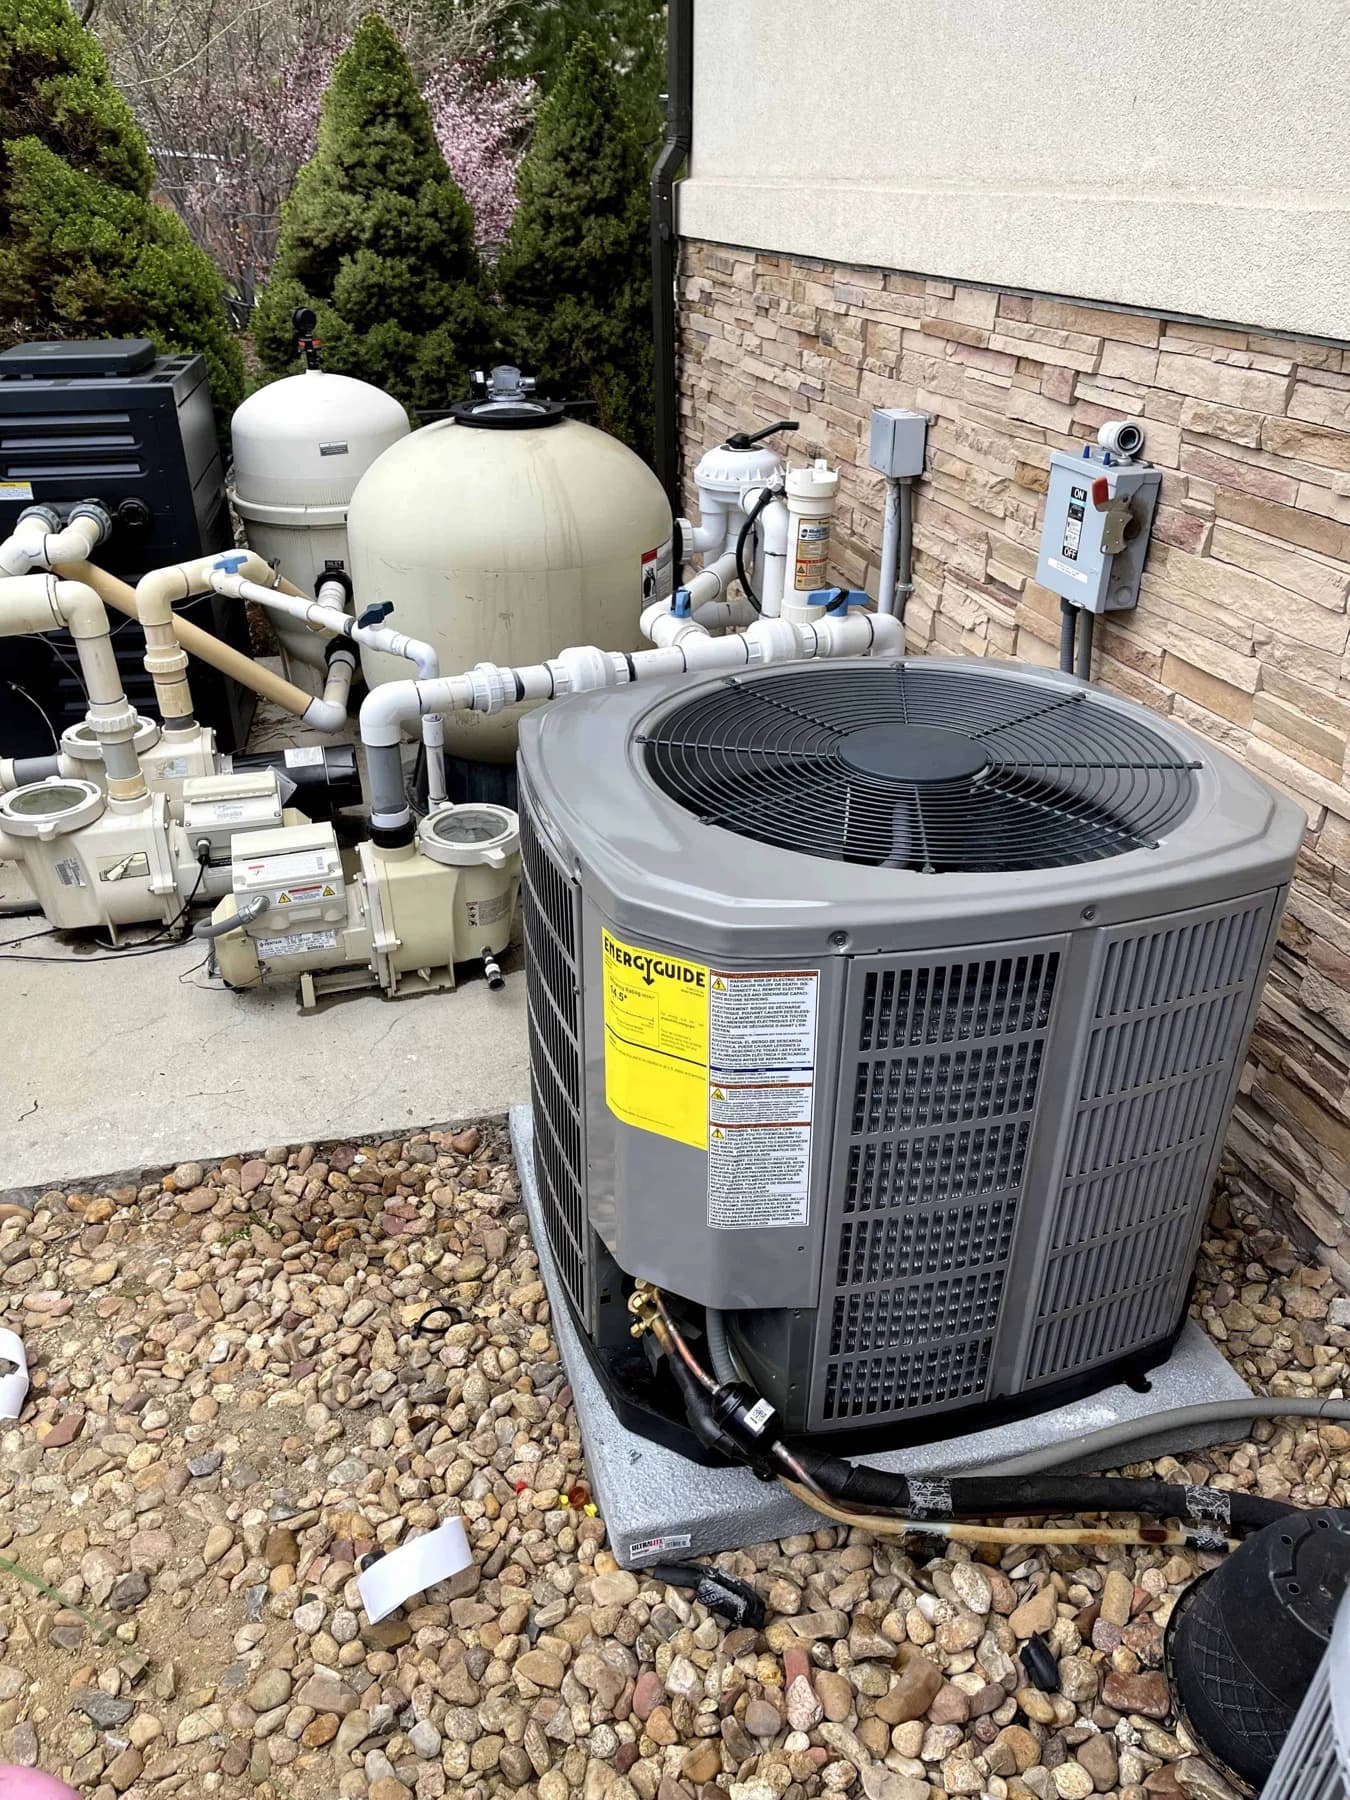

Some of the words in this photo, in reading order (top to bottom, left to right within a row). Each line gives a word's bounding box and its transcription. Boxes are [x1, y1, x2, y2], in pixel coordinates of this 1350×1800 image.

[1074, 489, 1084, 500] ON
[1064, 547, 1077, 559] OFF
[604, 936, 705, 988] ENERGYGUIDE
